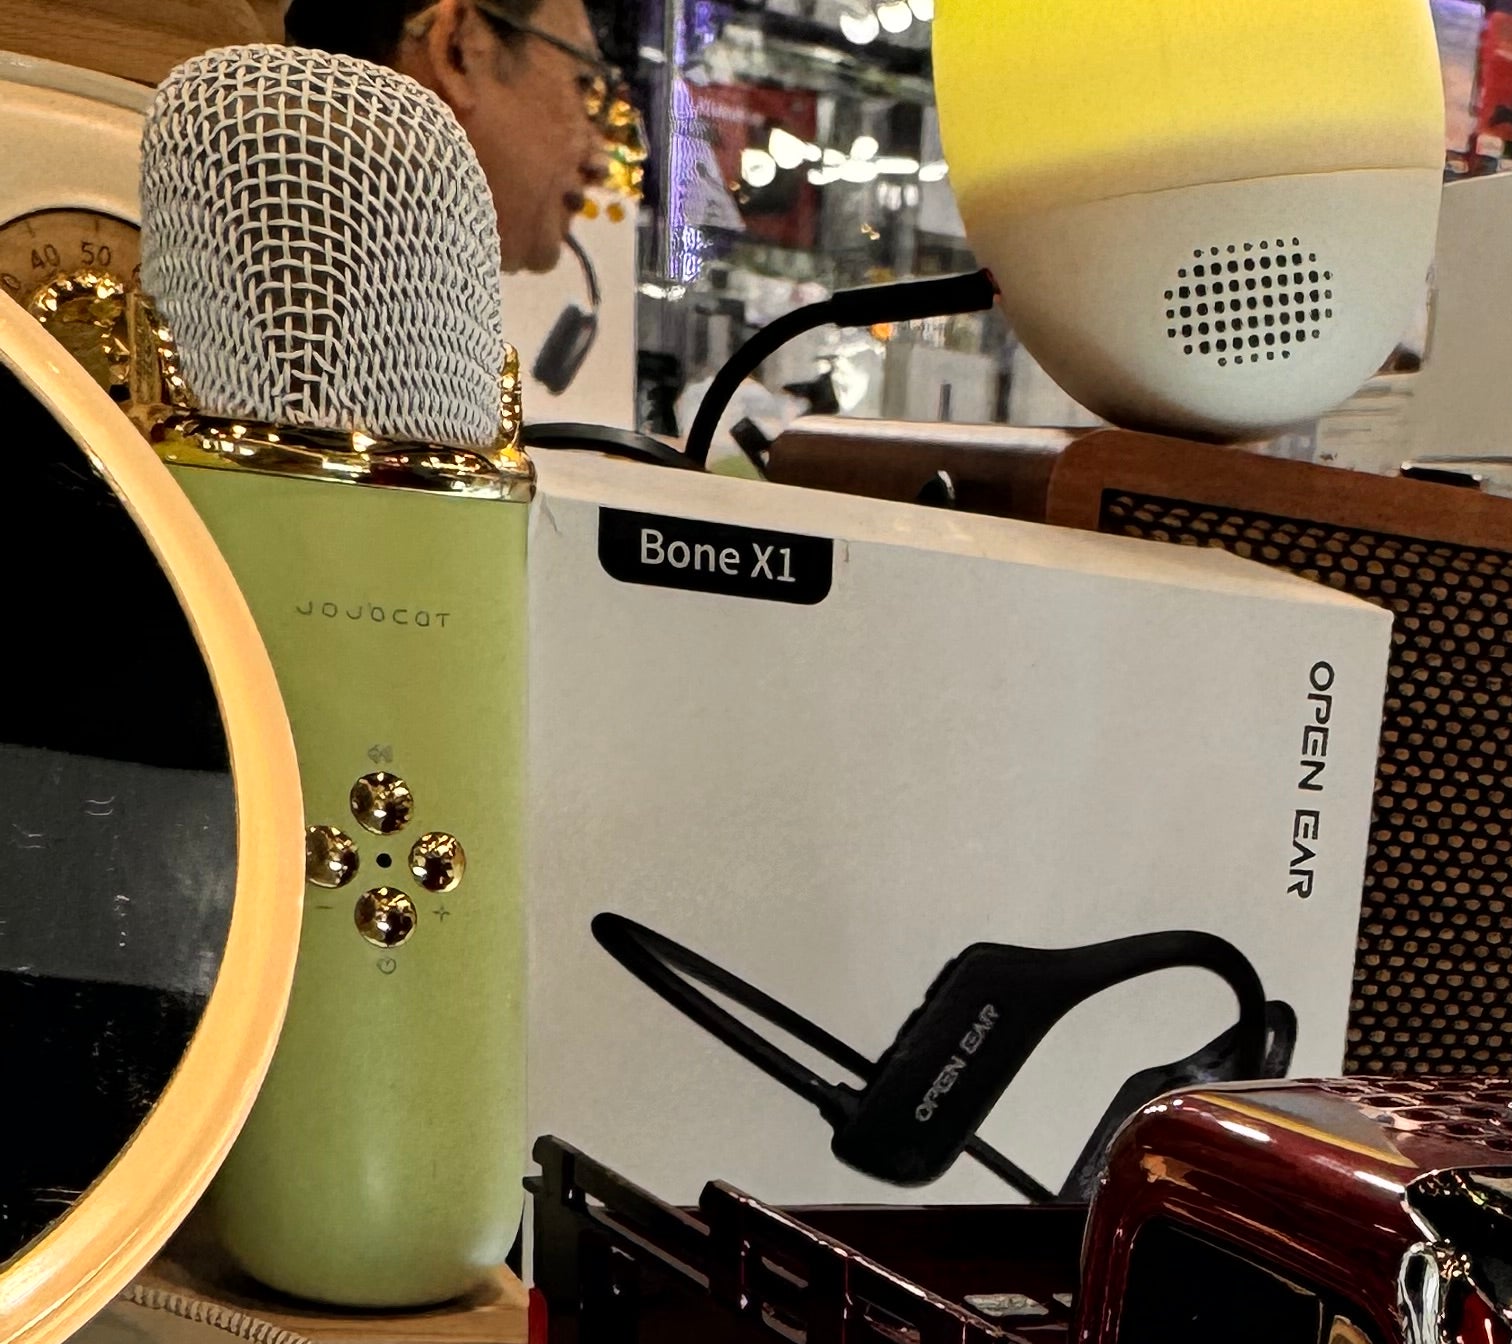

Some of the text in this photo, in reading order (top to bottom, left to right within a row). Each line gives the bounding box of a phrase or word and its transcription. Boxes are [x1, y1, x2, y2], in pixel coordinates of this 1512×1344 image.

[81, 241, 111, 266] 50
[640, 528, 796, 582] Bone X1
[1287, 661, 1334, 898] OPEN EAR
[915, 1004, 999, 1122] OPEN EAR
